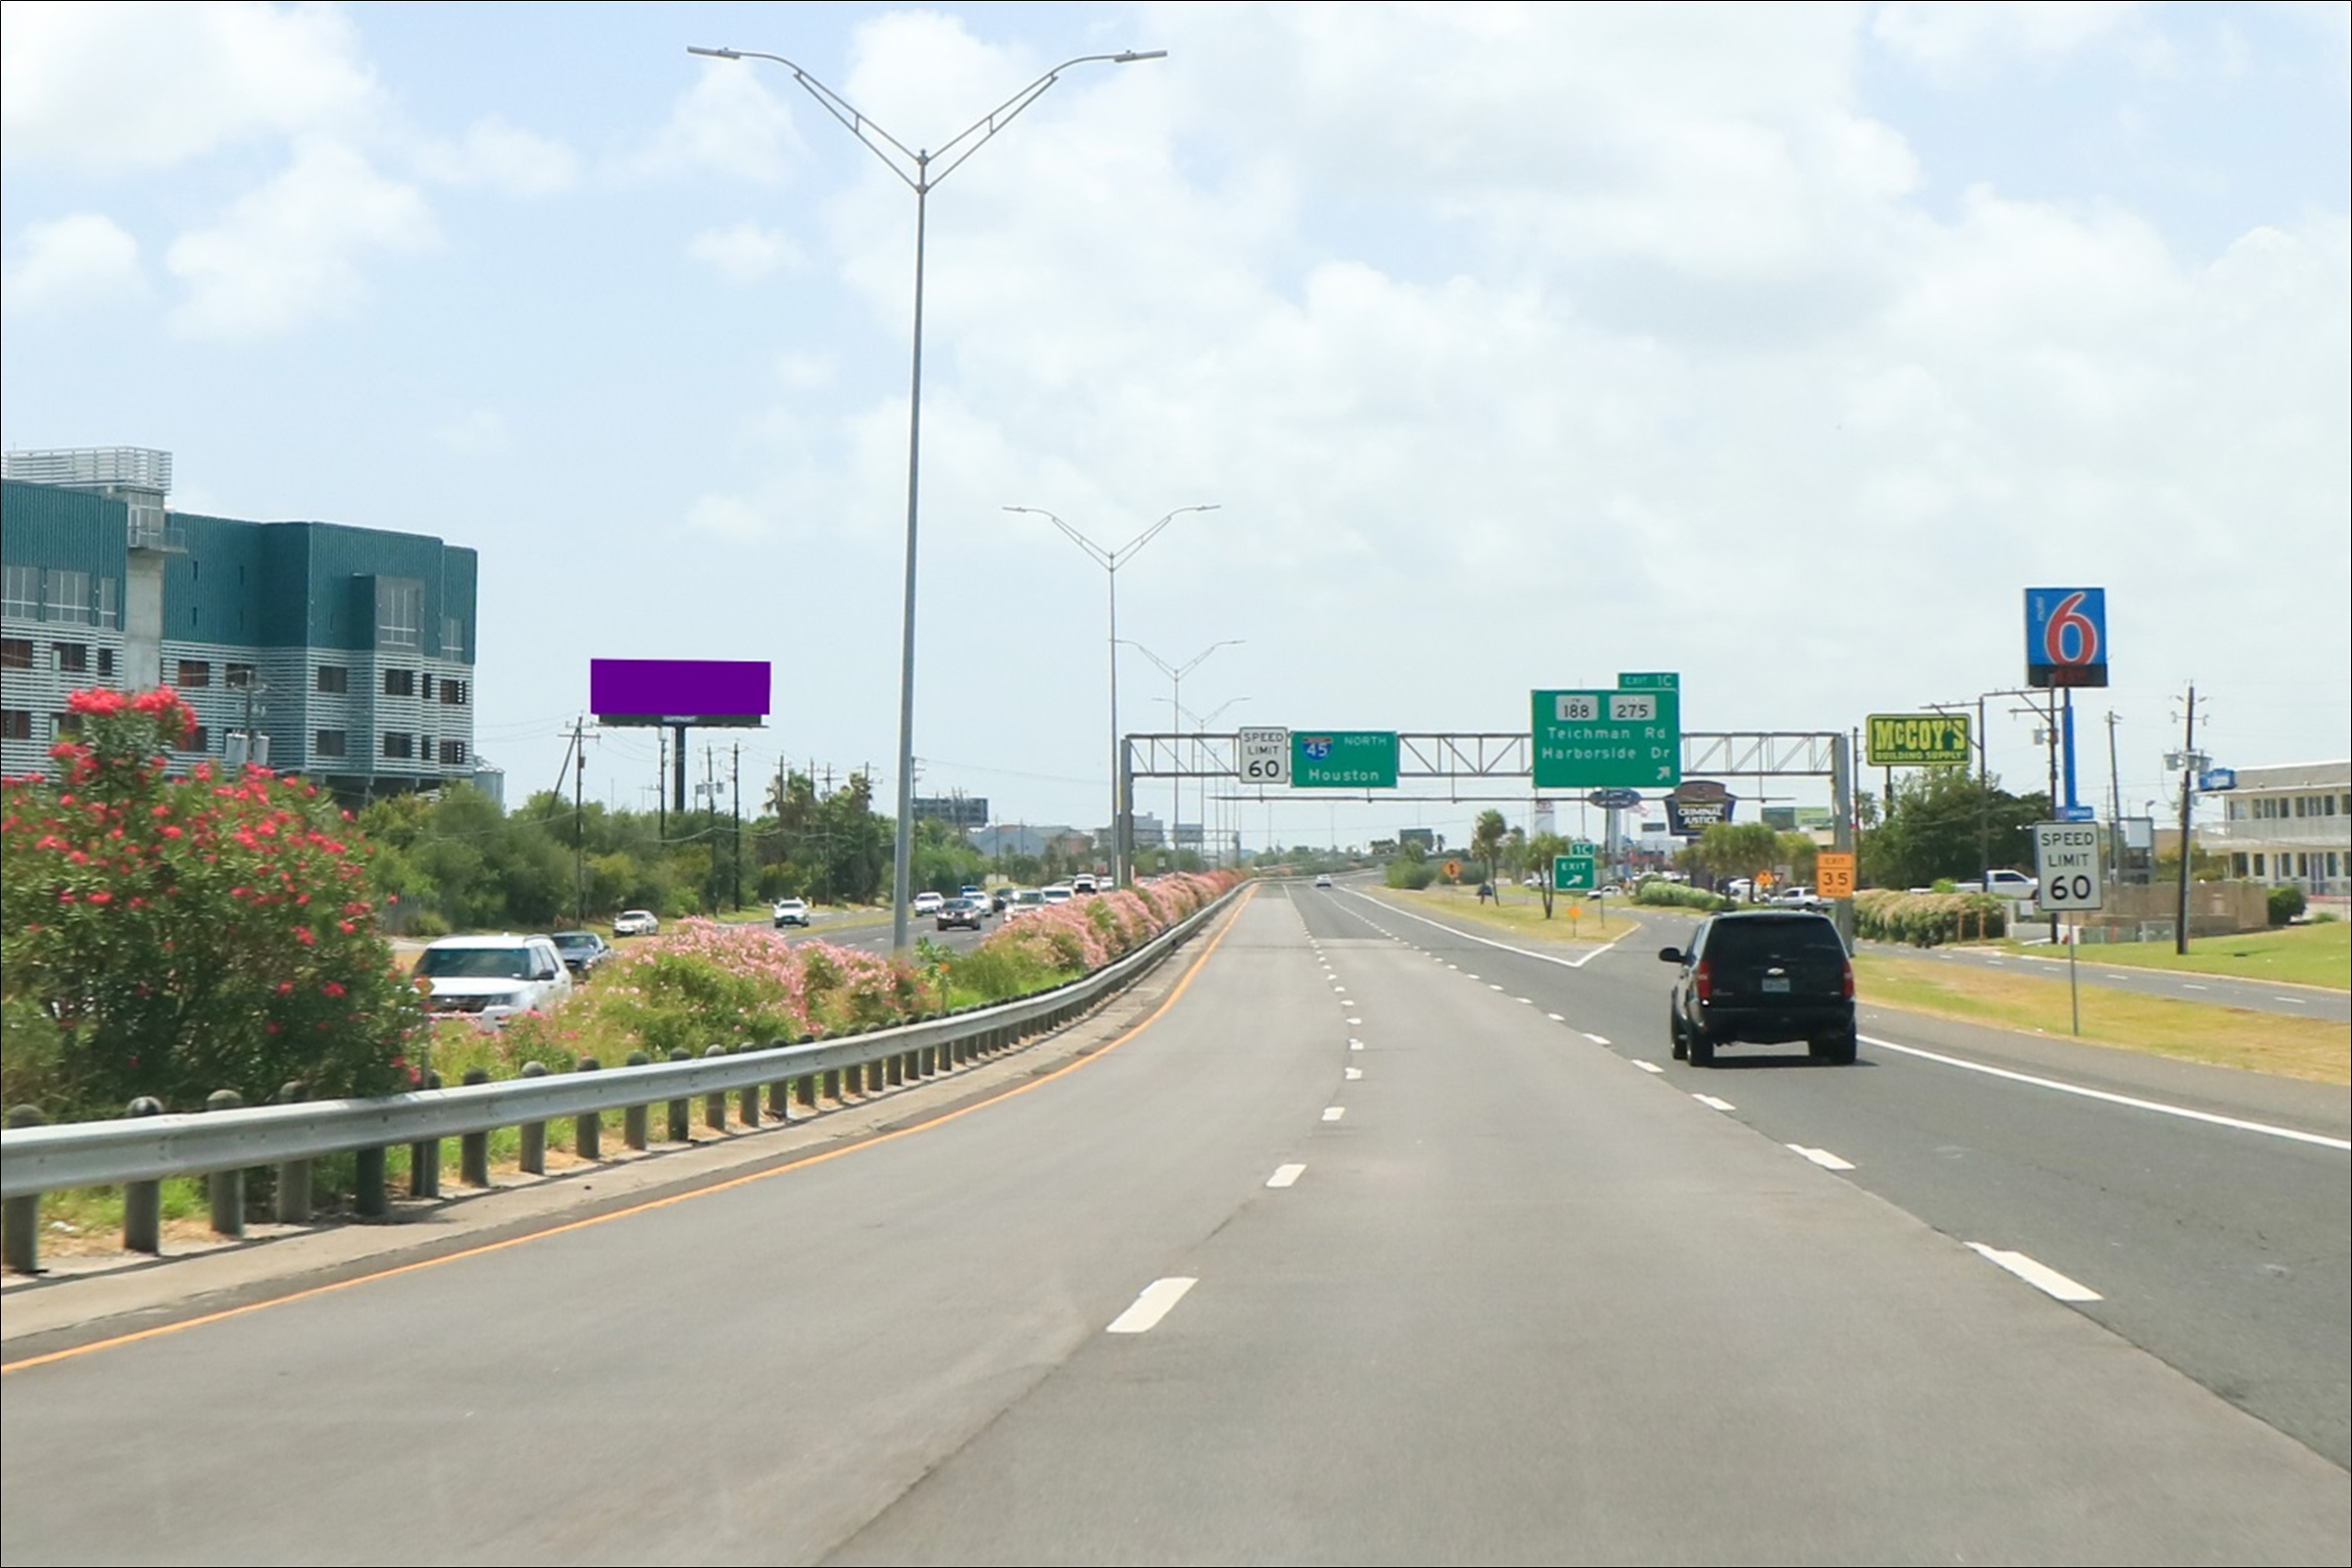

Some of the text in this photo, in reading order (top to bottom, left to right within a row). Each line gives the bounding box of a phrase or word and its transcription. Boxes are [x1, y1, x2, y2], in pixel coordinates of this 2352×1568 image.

[2044, 592, 2098, 665] 6
[1625, 675, 1673, 686] EXIT 1C
[1564, 705, 1590, 718] 188
[1617, 705, 1648, 718] 275
[1244, 733, 1284, 742] SPEED
[1547, 727, 1666, 739] Teichman Rd
[1345, 736, 1387, 746] NORTH
[1248, 746, 1278, 756] LIMIT
[1306, 743, 1329, 757] 45
[1542, 747, 1670, 760] Harborside Dr
[1249, 760, 1279, 777] 60
[1308, 769, 1379, 781] Houston
[2040, 832, 2094, 846] SPEED
[1576, 845, 1590, 856] 1C
[2048, 854, 2089, 867] LIMIT
[1823, 872, 1848, 886] 35
[2050, 874, 2091, 901] 60
